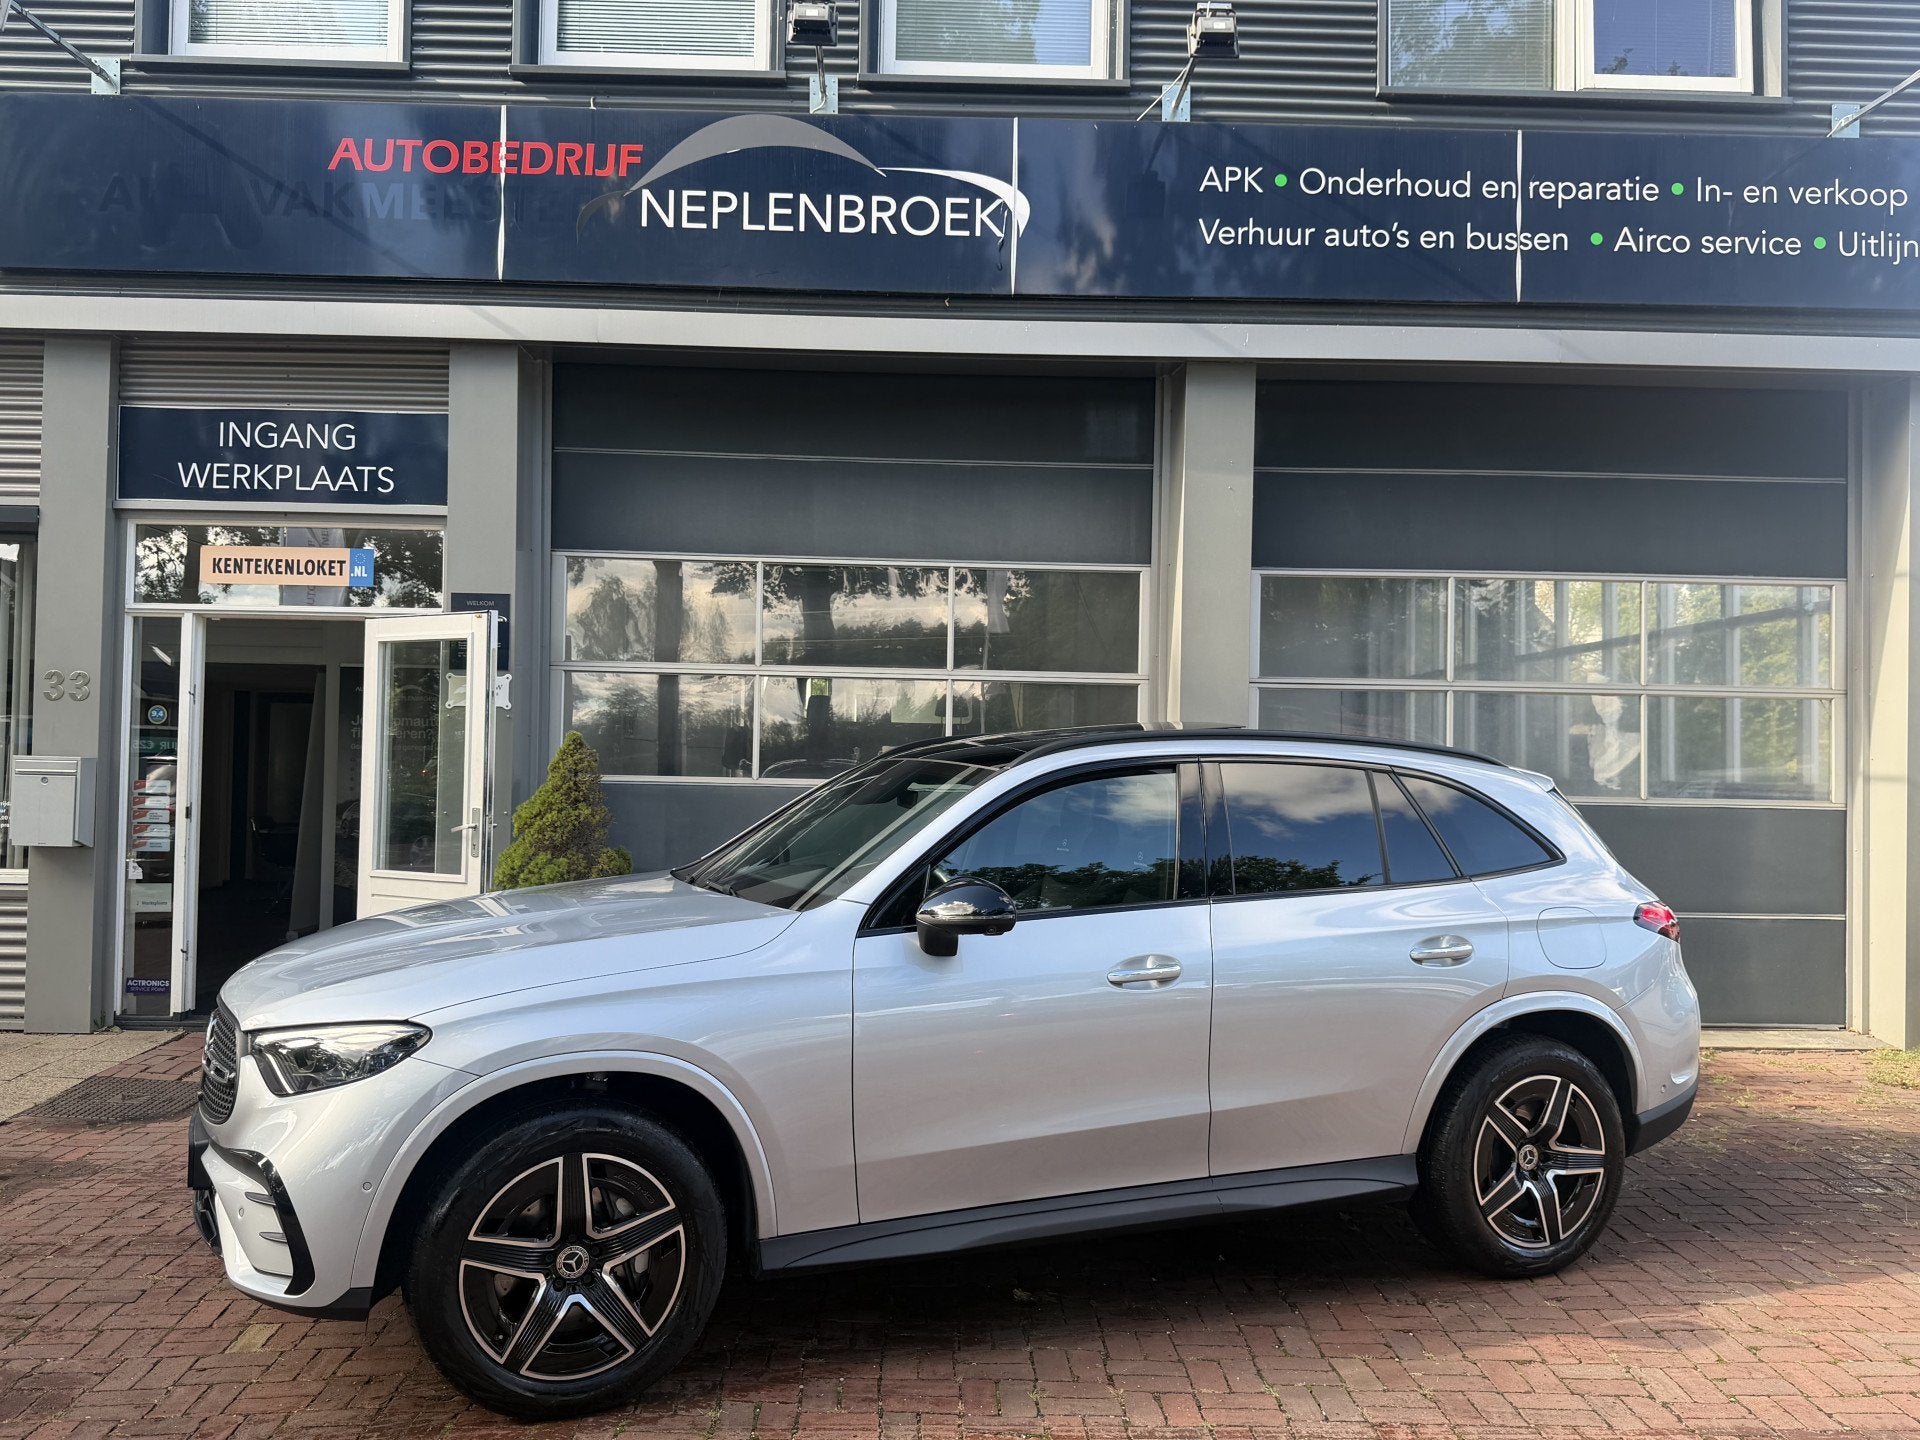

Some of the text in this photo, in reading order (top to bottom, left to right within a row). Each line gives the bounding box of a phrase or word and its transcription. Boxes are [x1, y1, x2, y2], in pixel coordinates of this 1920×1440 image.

[328, 136, 644, 178] AUTOBEDRIJF
[1199, 165, 1908, 216] APK Onderhoud en reparatie In- en verkoop
[640, 188, 1004, 238] NEPLENBROEK
[1198, 217, 1316, 246] Verhuur
[1419, 230, 1455, 250] en
[1466, 222, 1569, 252] bussen
[1613, 226, 1691, 254] Airco
[1700, 230, 1802, 256] service
[1838, 231, 1920, 266] Uitlijn
[218, 421, 357, 451] INGANG
[177, 462, 395, 493] WERKPLAATS
[211, 557, 347, 577] KENTEKENLOKET
[43, 669, 91, 701] 33
